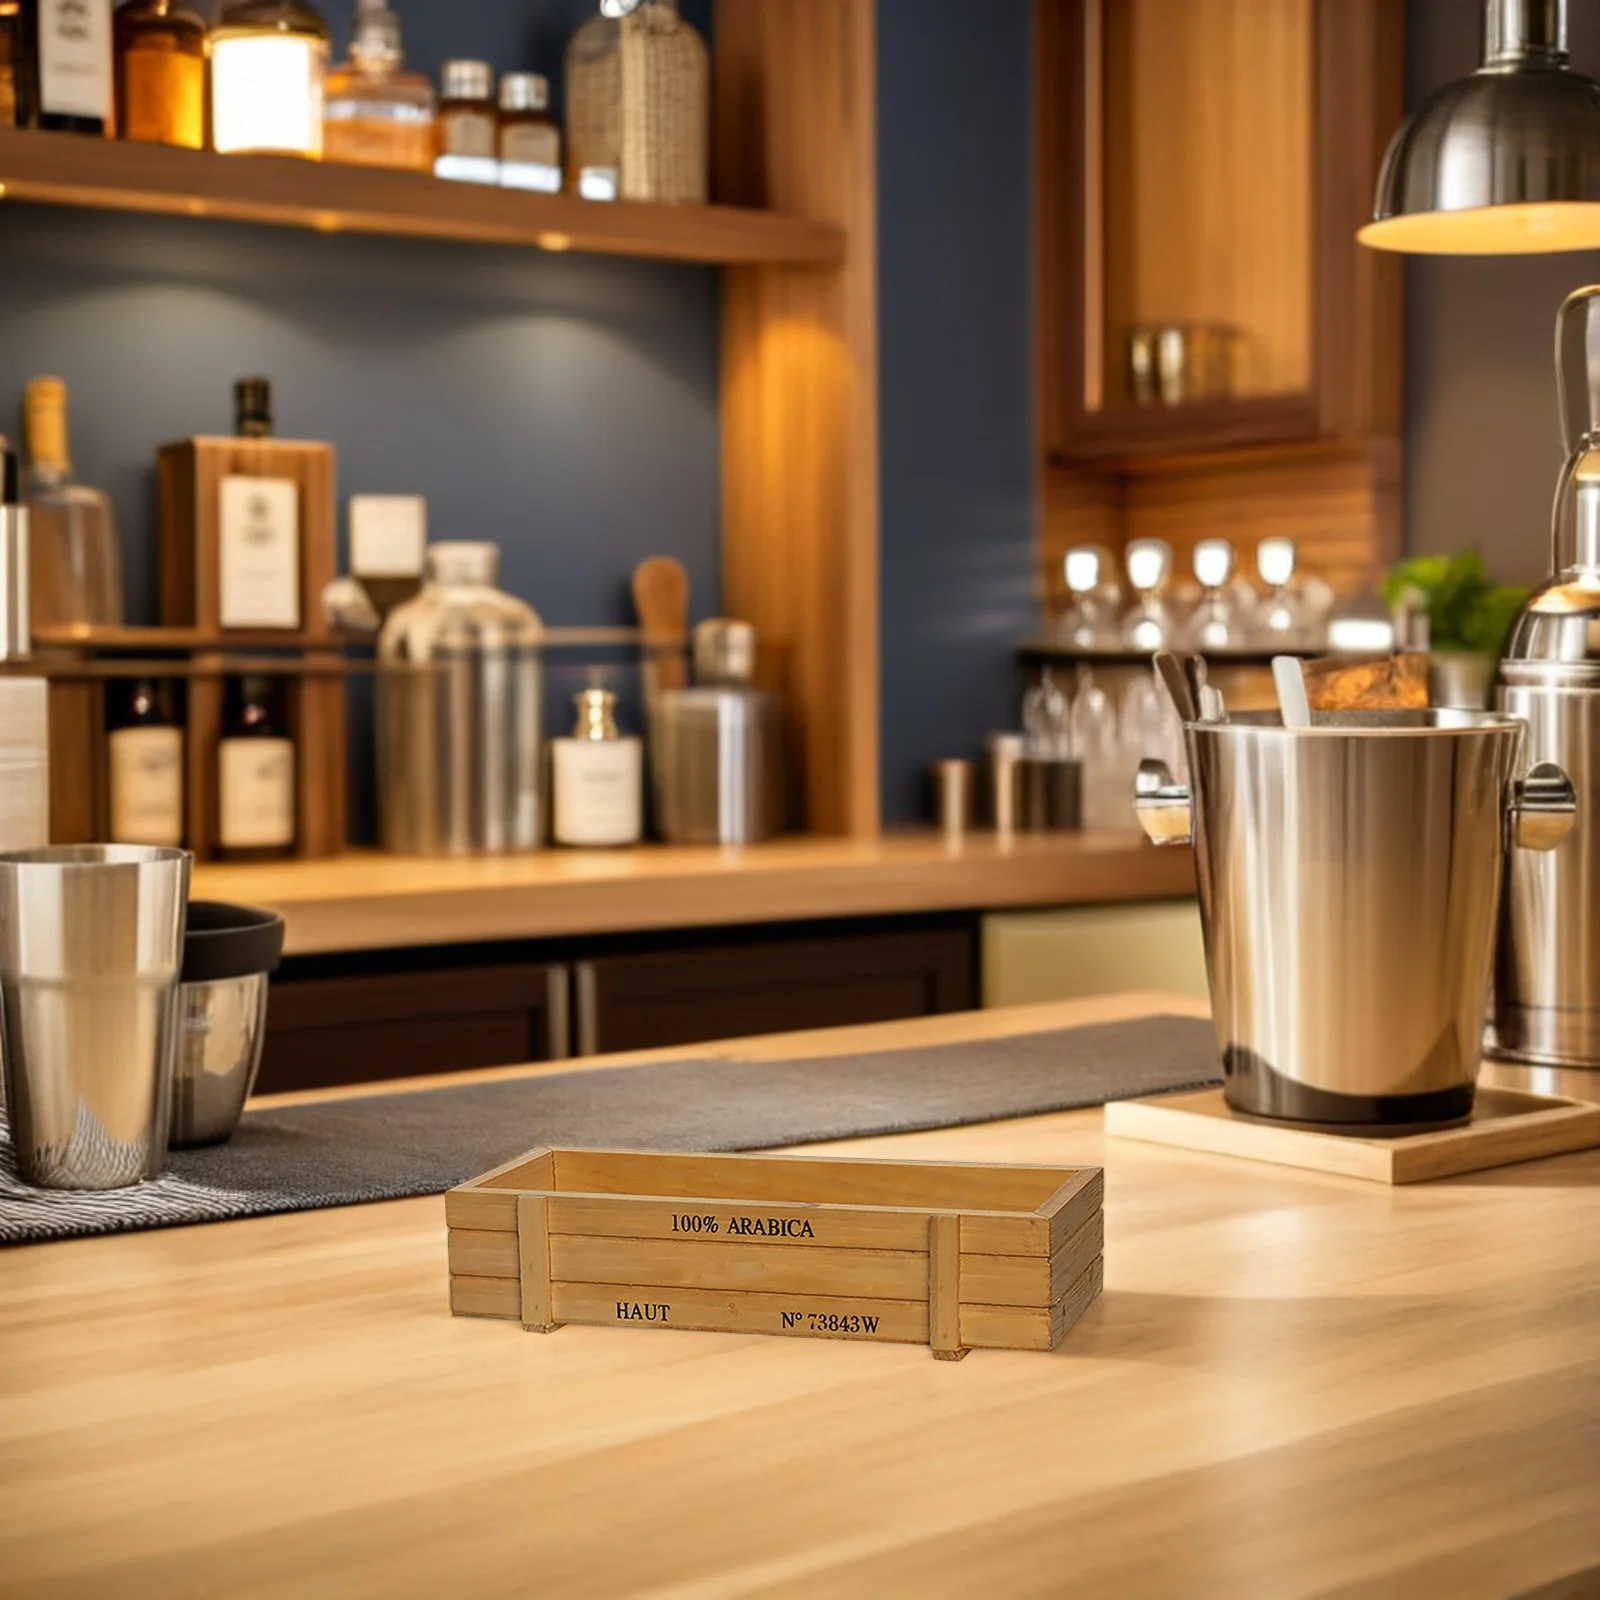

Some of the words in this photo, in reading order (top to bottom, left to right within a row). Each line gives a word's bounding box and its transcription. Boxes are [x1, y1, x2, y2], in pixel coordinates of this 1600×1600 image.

[671, 1214, 719, 1234] 100%
[726, 1216, 815, 1239] ARABICA
[616, 1302, 671, 1322] HAUT
[807, 1313, 880, 1334] 73843W
